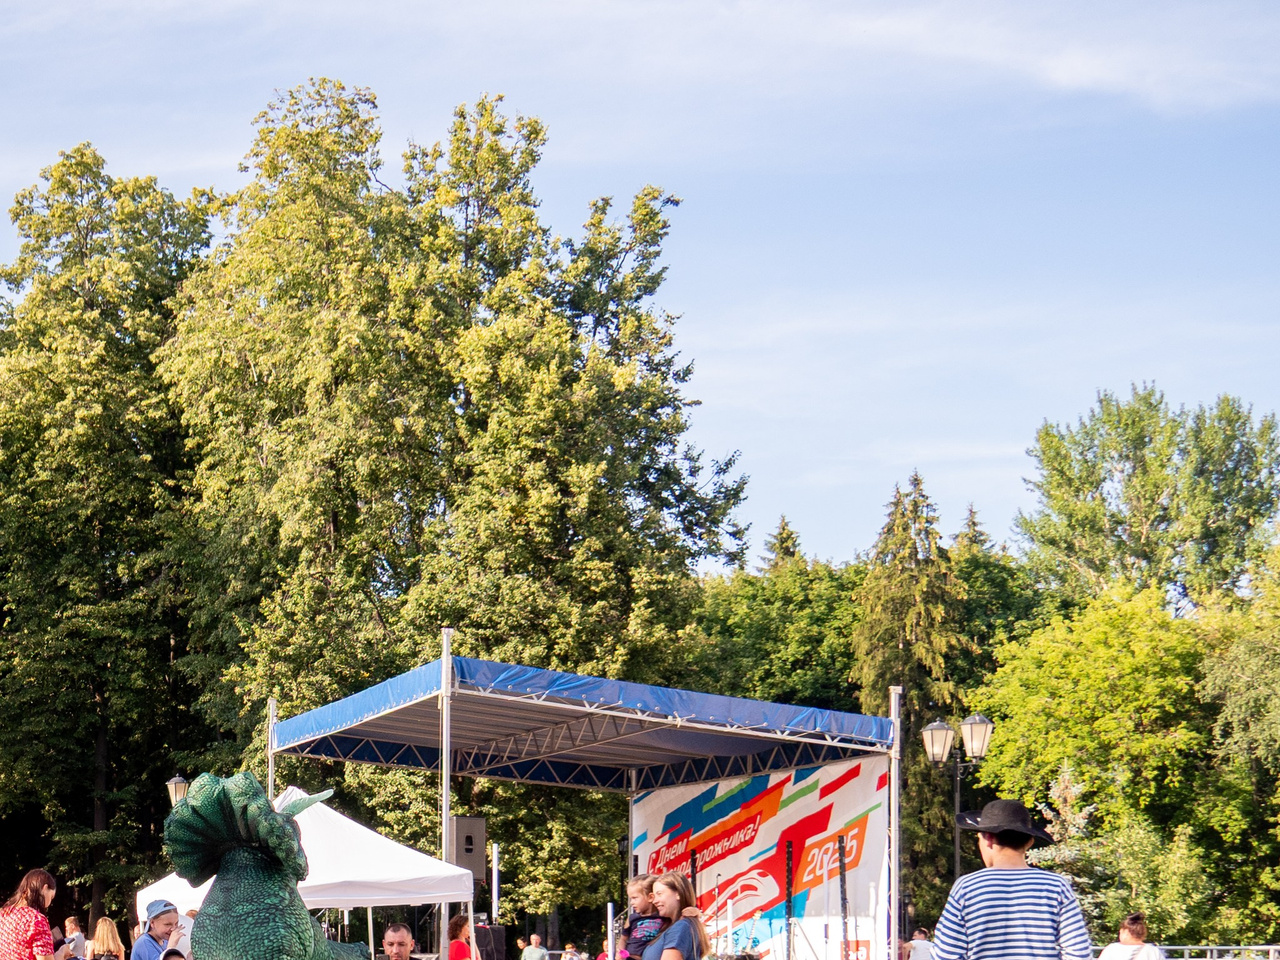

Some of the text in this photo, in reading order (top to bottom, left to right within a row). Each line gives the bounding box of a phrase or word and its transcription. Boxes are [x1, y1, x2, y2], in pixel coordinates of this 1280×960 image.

[648, 838, 688, 874] С Днем
[802, 828, 858, 883] 2025
